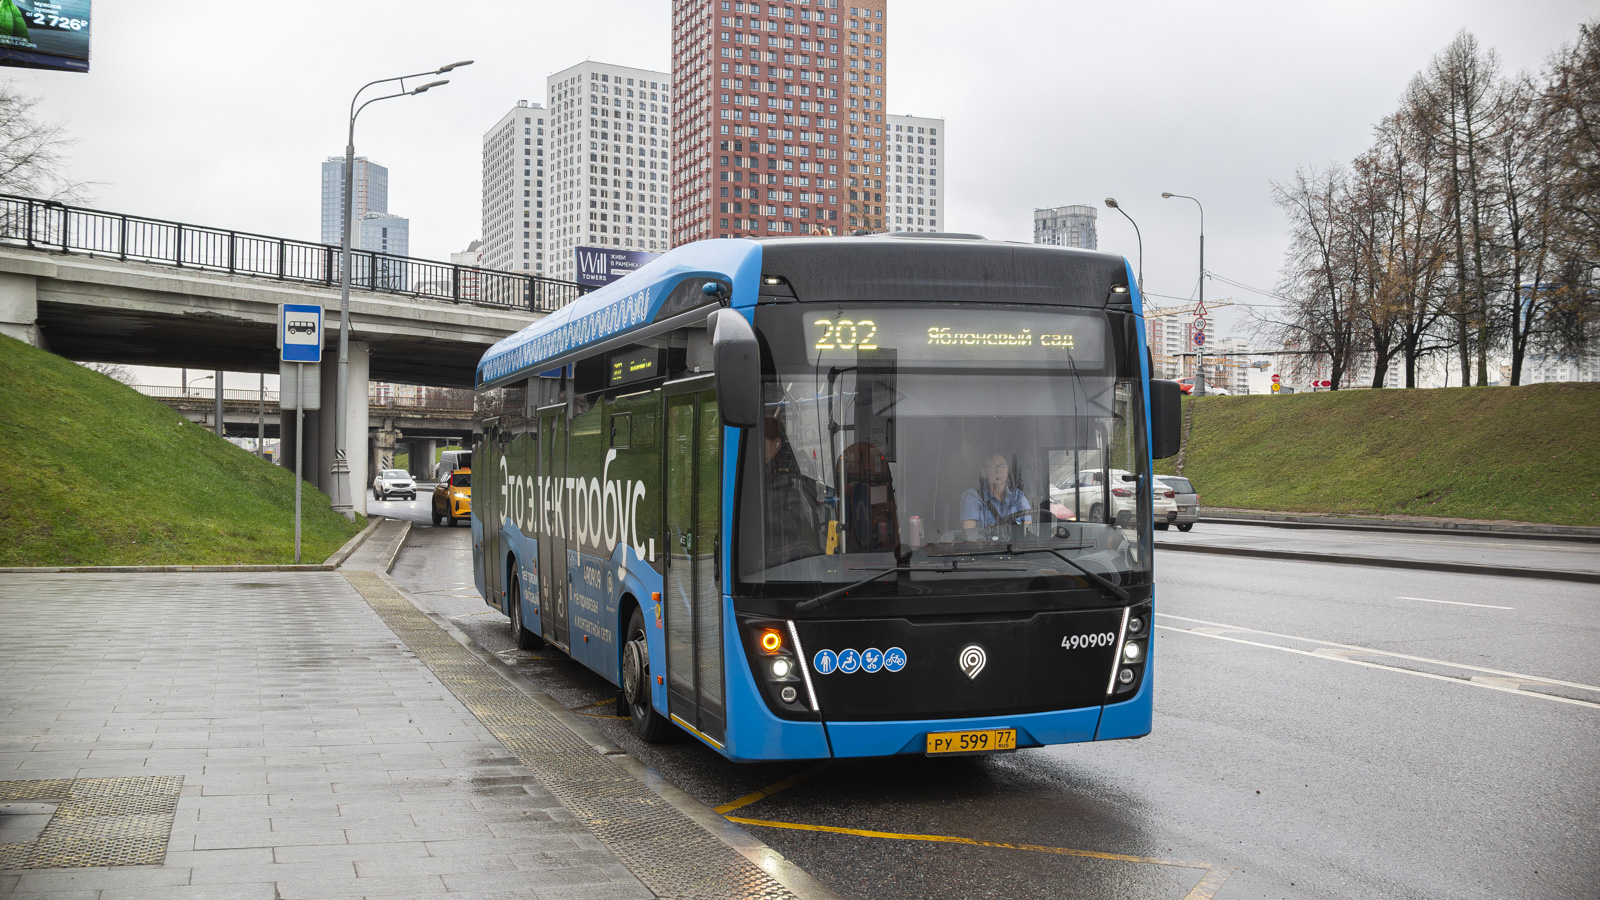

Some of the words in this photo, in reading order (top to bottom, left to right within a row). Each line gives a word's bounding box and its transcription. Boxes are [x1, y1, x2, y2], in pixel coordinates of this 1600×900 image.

[580, 251, 607, 274] Will
[814, 320, 877, 349] 202
[1040, 334, 1074, 349] сад
[500, 455, 524, 529] Это
[526, 449, 655, 581] электробус.
[1061, 632, 1115, 650] 490909
[960, 734, 988, 749] 599
[997, 731, 1011, 743] 77
